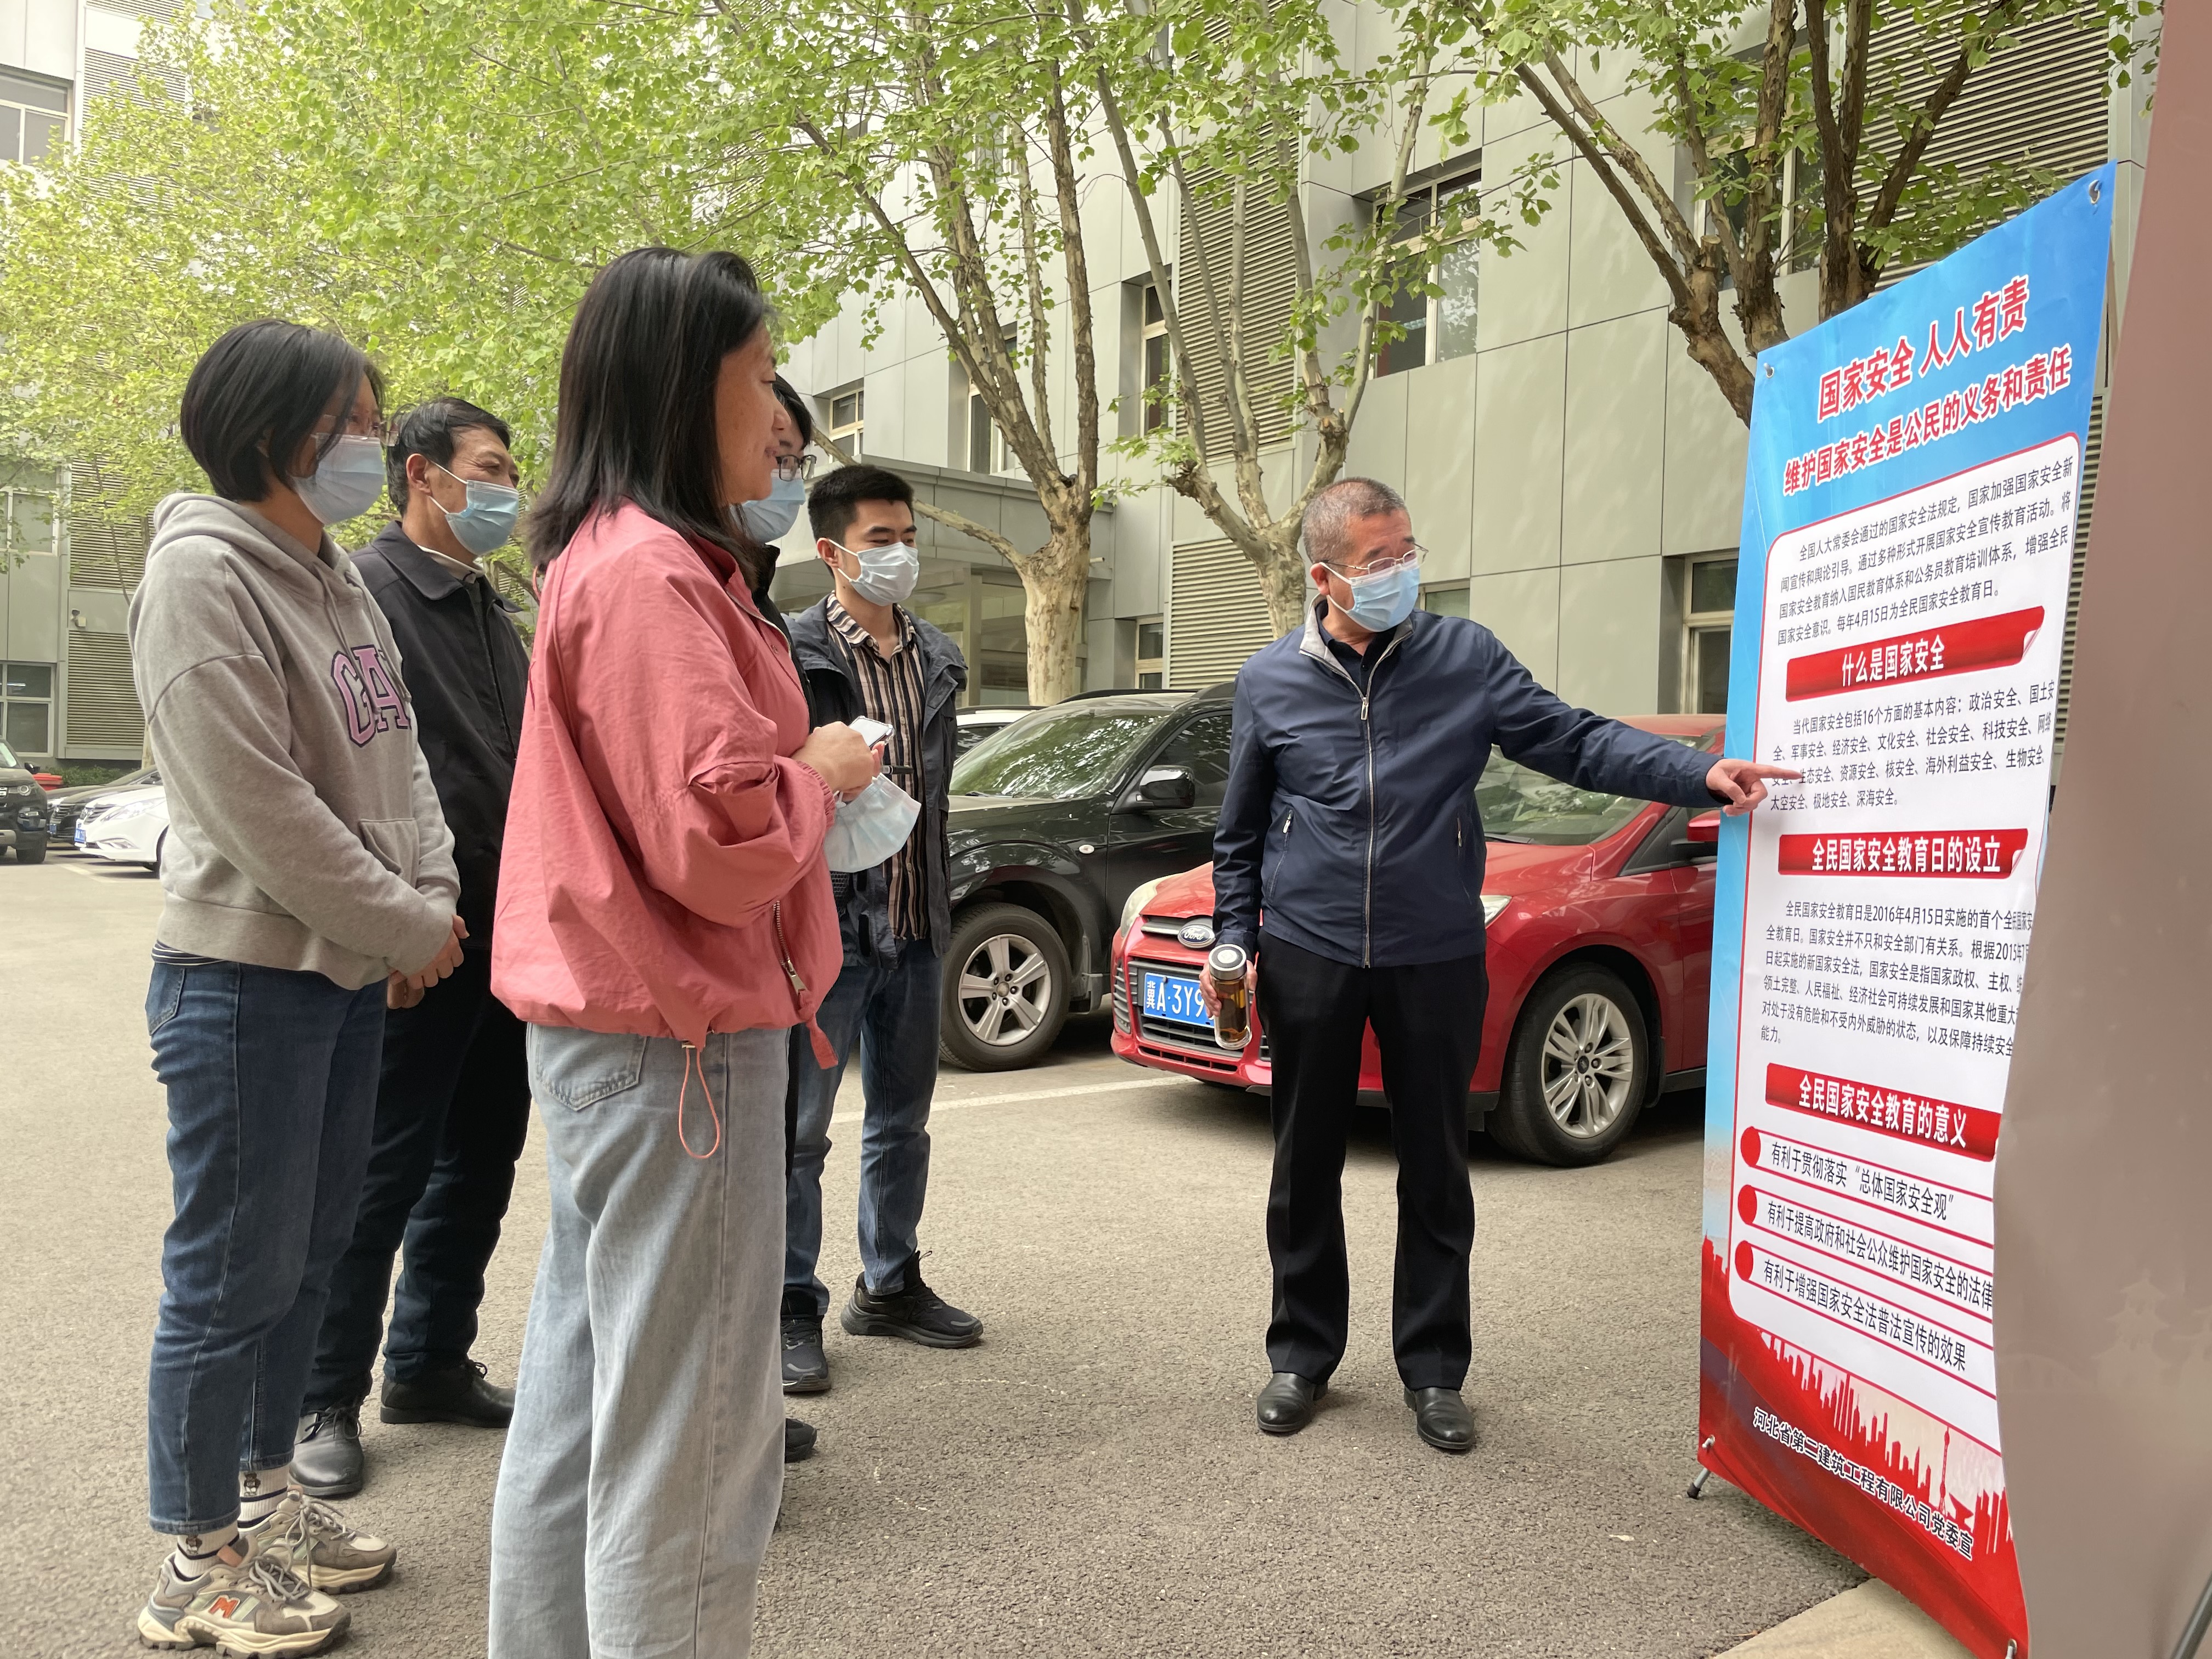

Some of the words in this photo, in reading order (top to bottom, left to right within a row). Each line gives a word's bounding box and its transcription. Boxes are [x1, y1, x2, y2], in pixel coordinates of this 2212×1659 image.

[1818, 337, 1914, 421] 国家安全
[1921, 277, 2028, 374] 人人有责
[1784, 346, 2071, 494] 维护国家安全是公民的义务和责任
[331, 644, 413, 748] GA
[1842, 634, 1944, 687] 什么是国家安全
[1770, 788, 1898, 811] 太空安全、极地安全、深海安全。
[1812, 835, 2001, 873] 全民国家安全教育日的设立
[1184, 928, 1206, 940] Ford
[1761, 1025, 1781, 1043] 能力。
[1764, 975, 2018, 1025] 领土完整、人民福祉、经济社会可持续发展和国家其他重大
[1798, 1074, 1967, 1149] 全民国家安全教育的意义
[1768, 1201, 1992, 1311] 有利于提高政府和社会公众维护国家安全的法律
[1764, 1259, 1966, 1372] 有利于增强国家安全法普法宣传的效果
[1754, 1408, 1973, 1560] 河北省第二建筑工程有限公司党委宣
